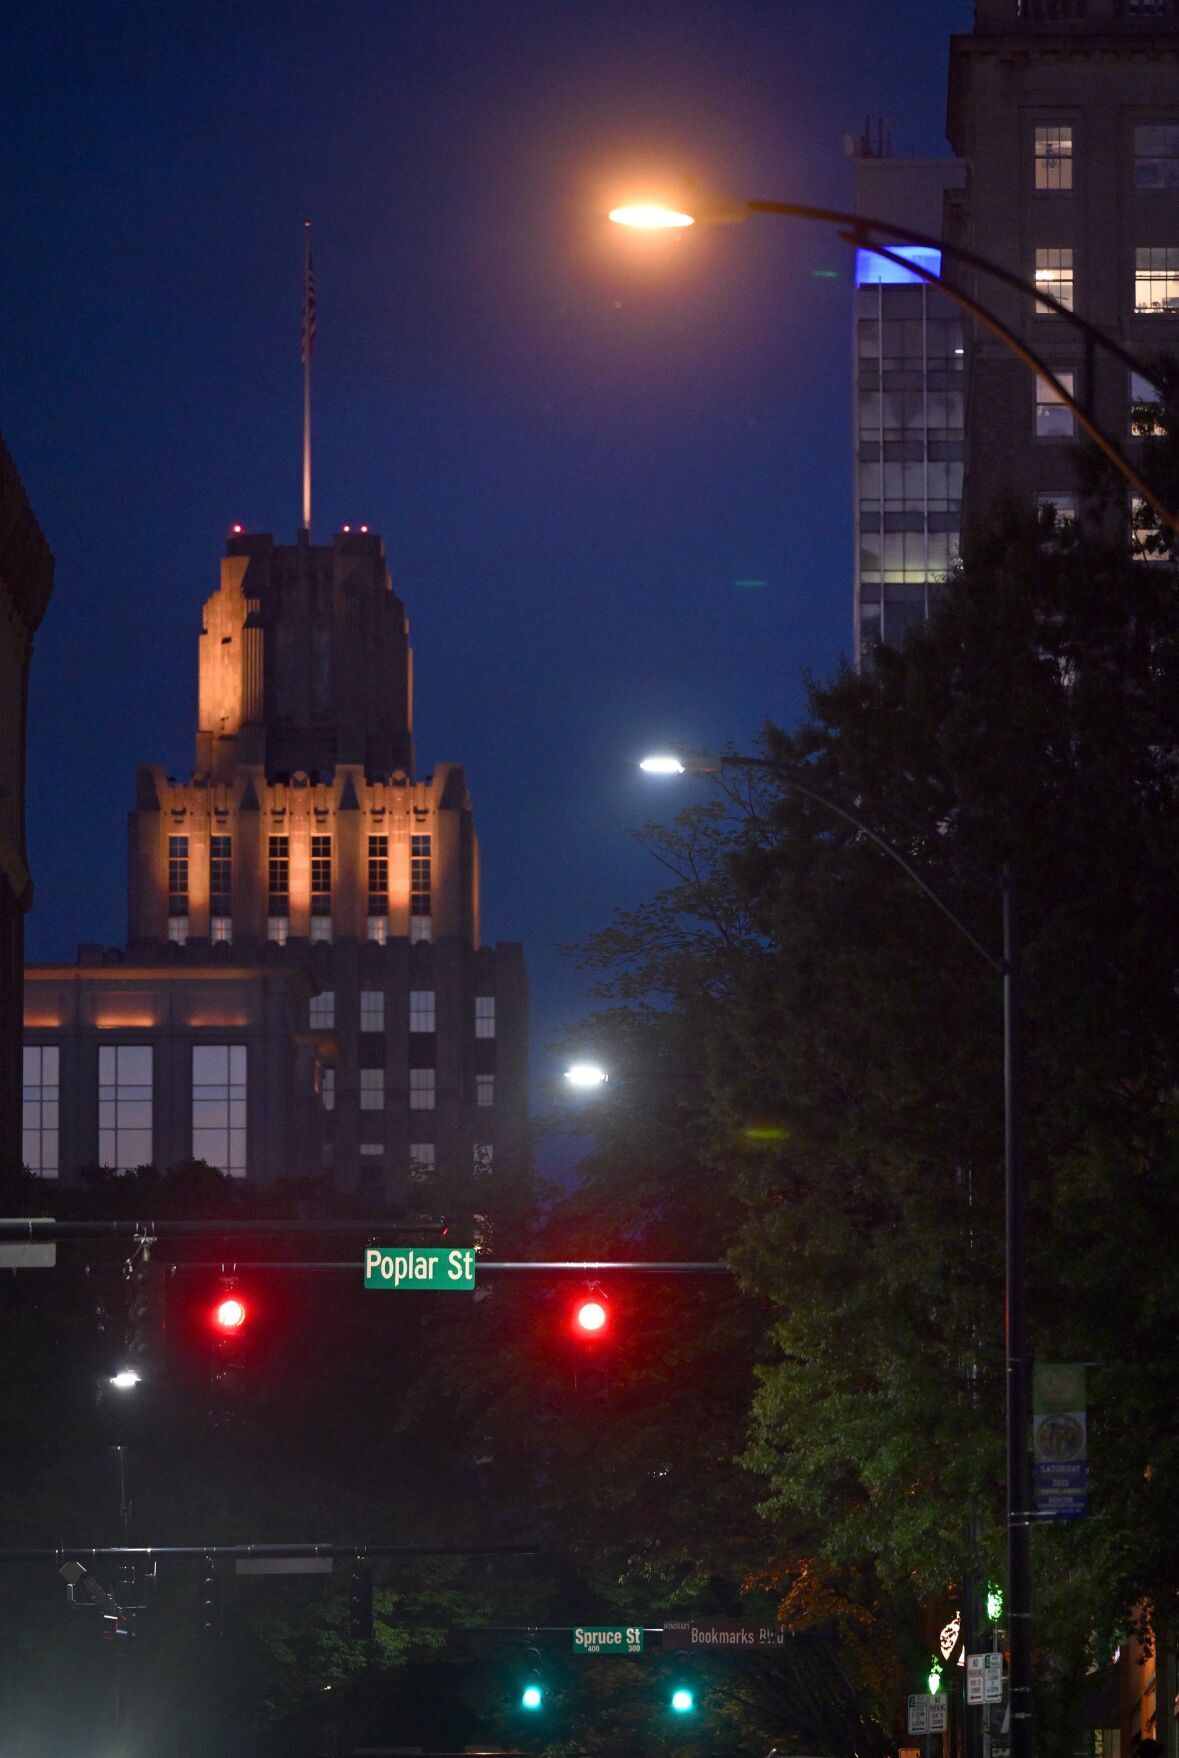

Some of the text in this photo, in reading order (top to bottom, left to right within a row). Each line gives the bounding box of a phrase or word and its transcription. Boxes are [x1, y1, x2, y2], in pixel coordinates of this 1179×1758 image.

[366, 1250, 473, 1286] Poplar St
[1040, 1464, 1080, 1473] SATURDAY
[575, 1628, 641, 1647] Spruce St
[691, 1627, 754, 1644] Bookmarks
